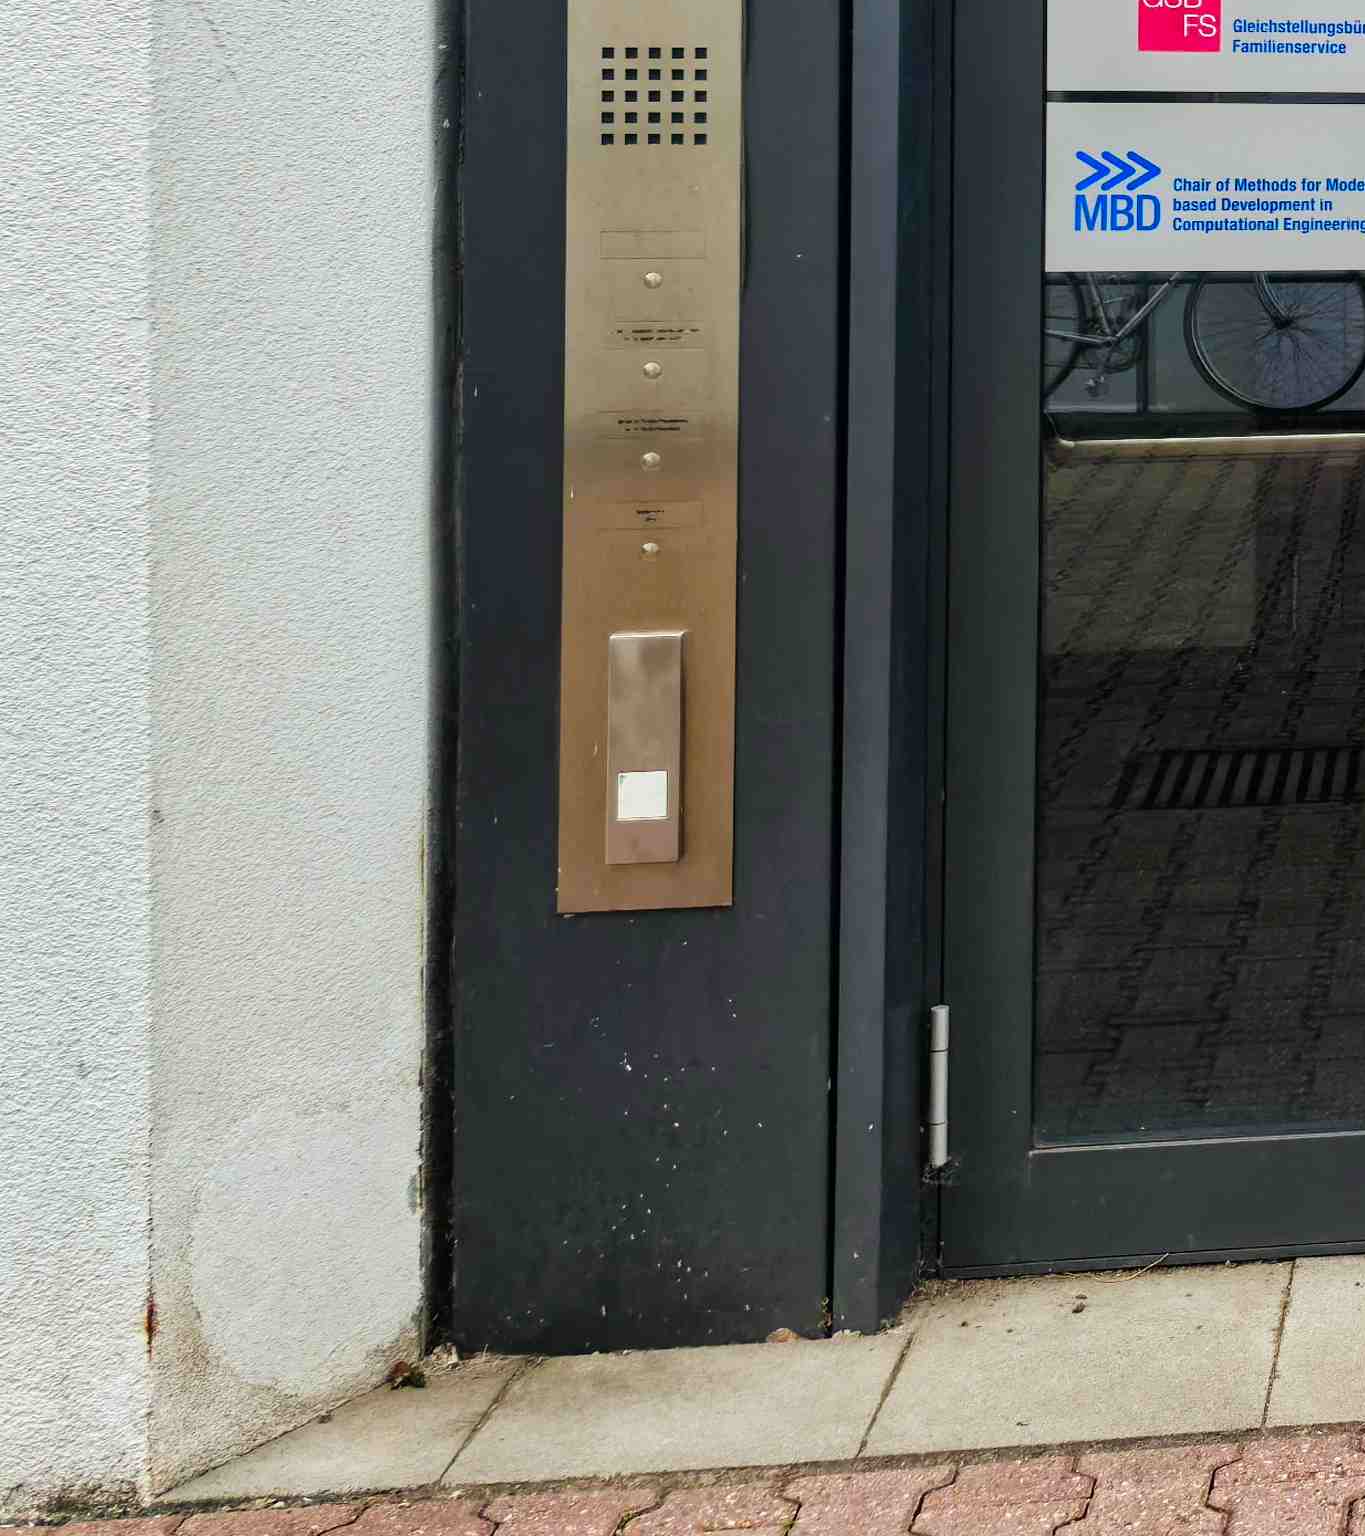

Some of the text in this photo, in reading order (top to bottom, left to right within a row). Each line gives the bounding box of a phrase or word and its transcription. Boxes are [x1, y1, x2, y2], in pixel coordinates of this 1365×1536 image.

[1183, 14, 1217, 38] FS
[1232, 39, 1346, 54] Familienservice
[1173, 177, 1211, 192] Chair
[1215, 177, 1230, 192] of
[1234, 177, 1297, 192] Methods
[1301, 177, 1322, 192] for
[1074, 194, 1162, 232] MBD
[1173, 197, 1333, 214] based Development in
[1172, 217, 1279, 234] Computational
